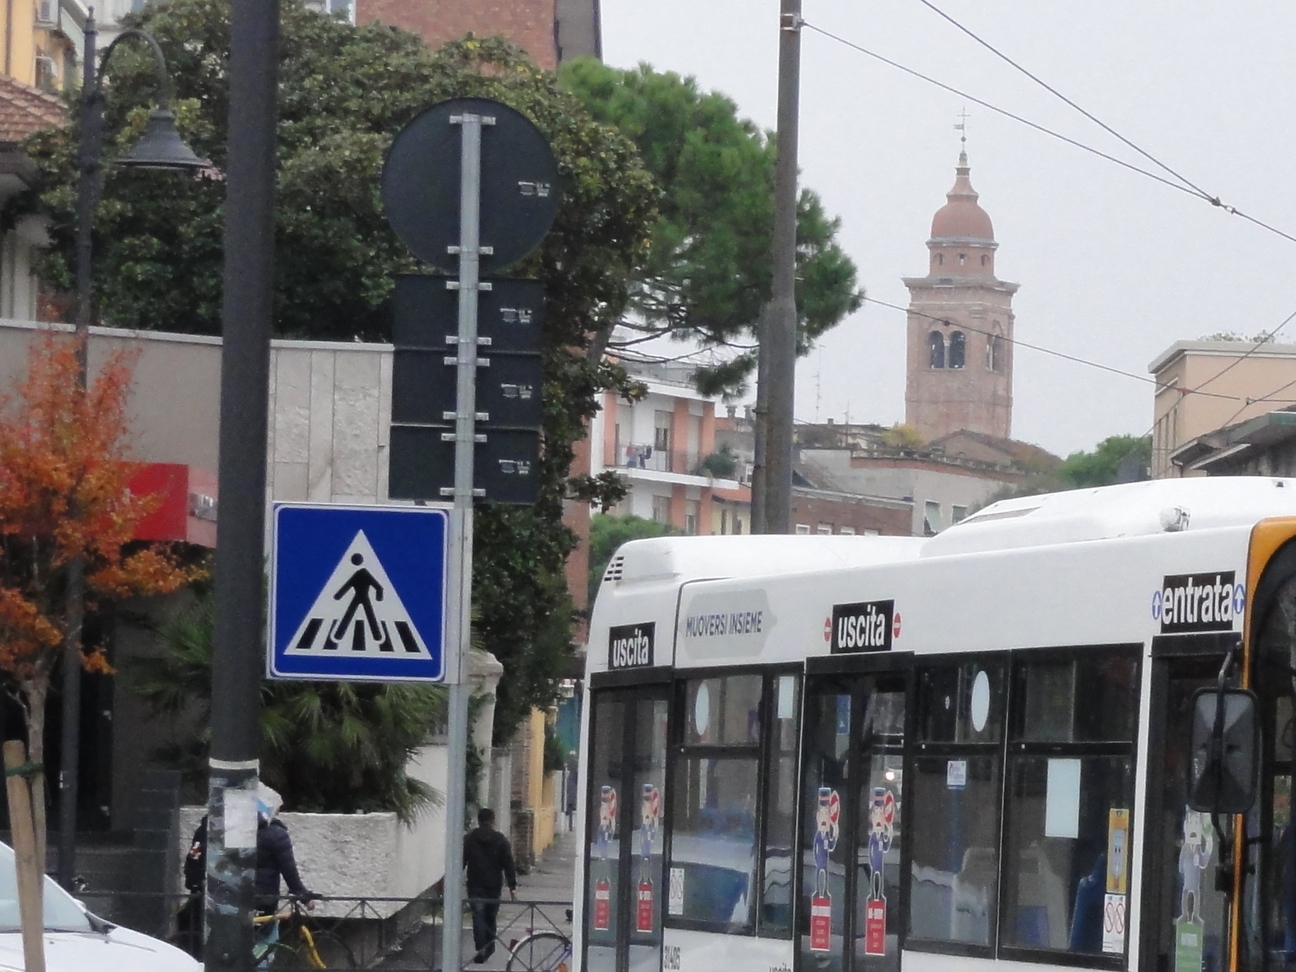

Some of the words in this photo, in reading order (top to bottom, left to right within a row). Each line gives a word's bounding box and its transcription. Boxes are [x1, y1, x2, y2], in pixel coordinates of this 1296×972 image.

[1162, 575, 1234, 624] entrata
[686, 613, 727, 637] MUOVERSI
[729, 611, 763, 634] INSIEME
[838, 604, 885, 649] uscita
[613, 628, 649, 667] uscita
